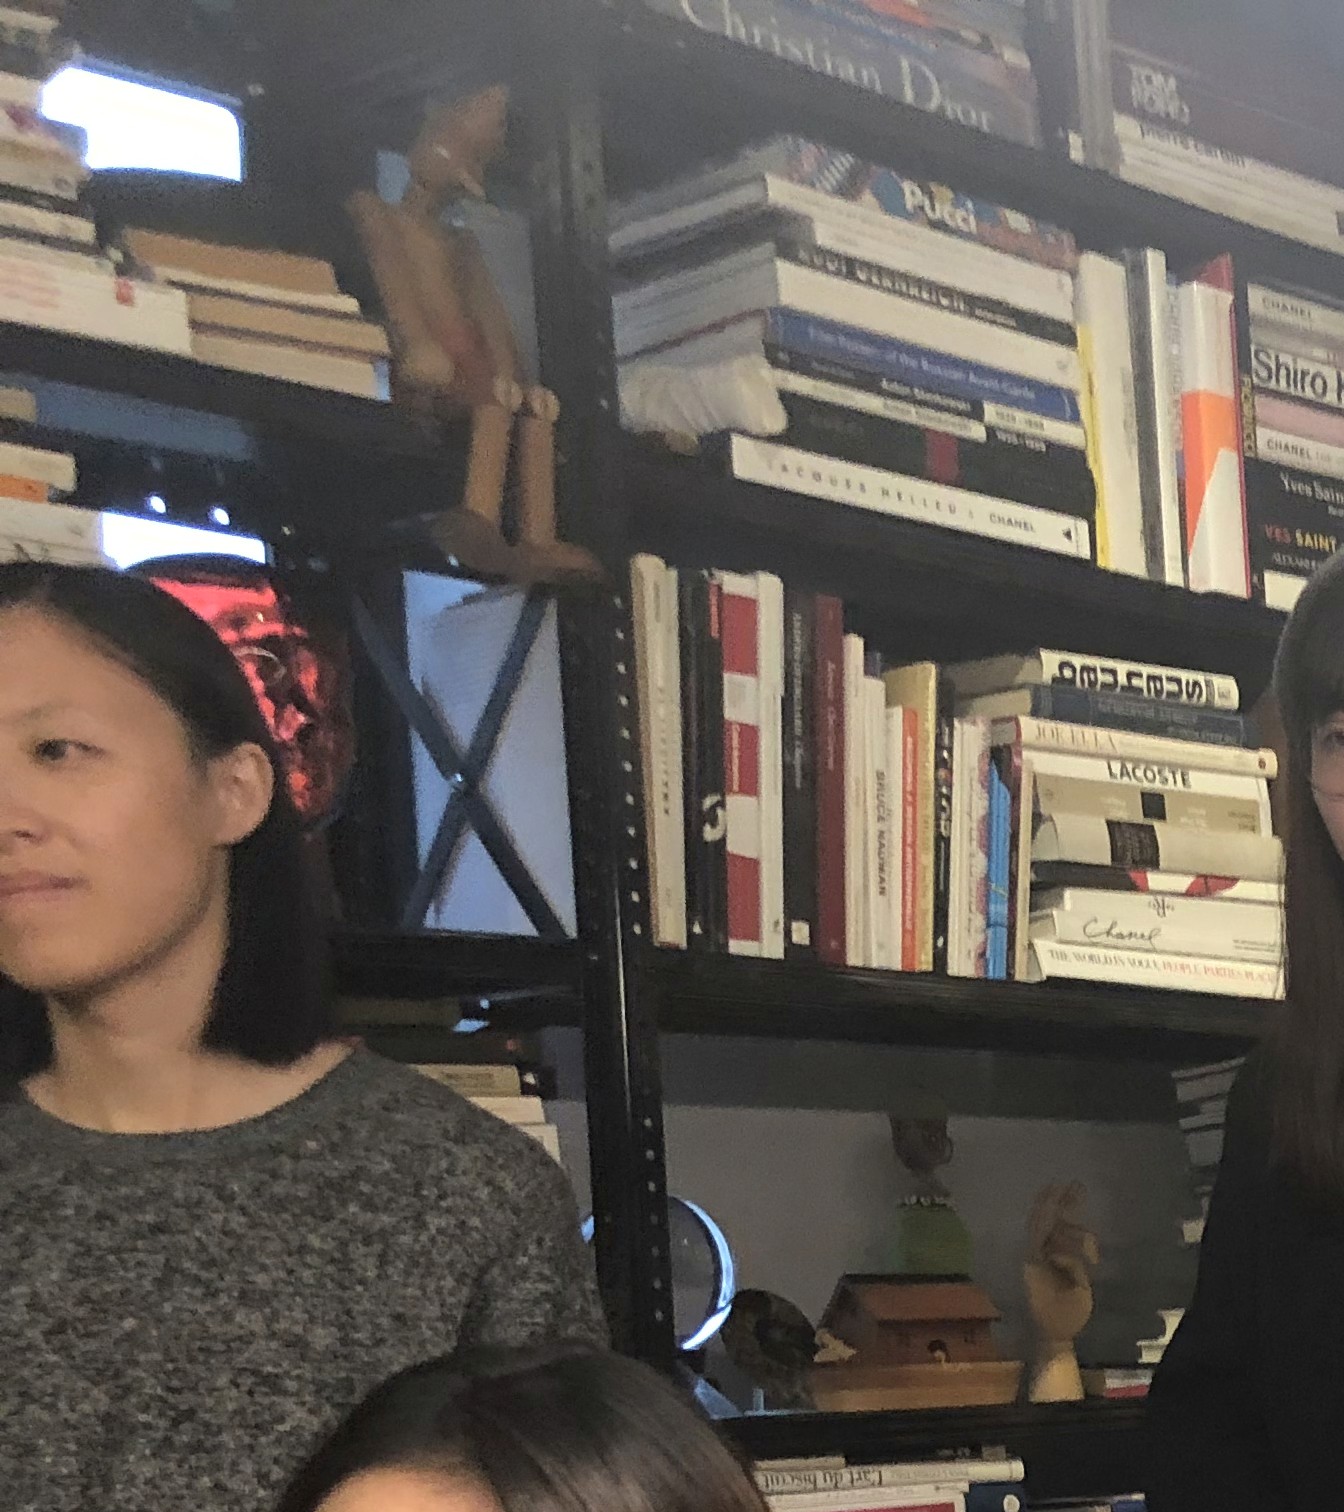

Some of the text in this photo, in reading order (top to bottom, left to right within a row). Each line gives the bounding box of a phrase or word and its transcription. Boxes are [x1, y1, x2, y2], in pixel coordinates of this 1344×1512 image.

[1261, 297, 1312, 321] CHANEL
[1253, 347, 1329, 400] Shiro
[1266, 437, 1313, 461] CHANEL
[1280, 472, 1313, 498] Yves
[989, 512, 1037, 534] CHANEL
[1107, 759, 1192, 790] LACOSTE
[1082, 917, 1165, 952] Chanel
